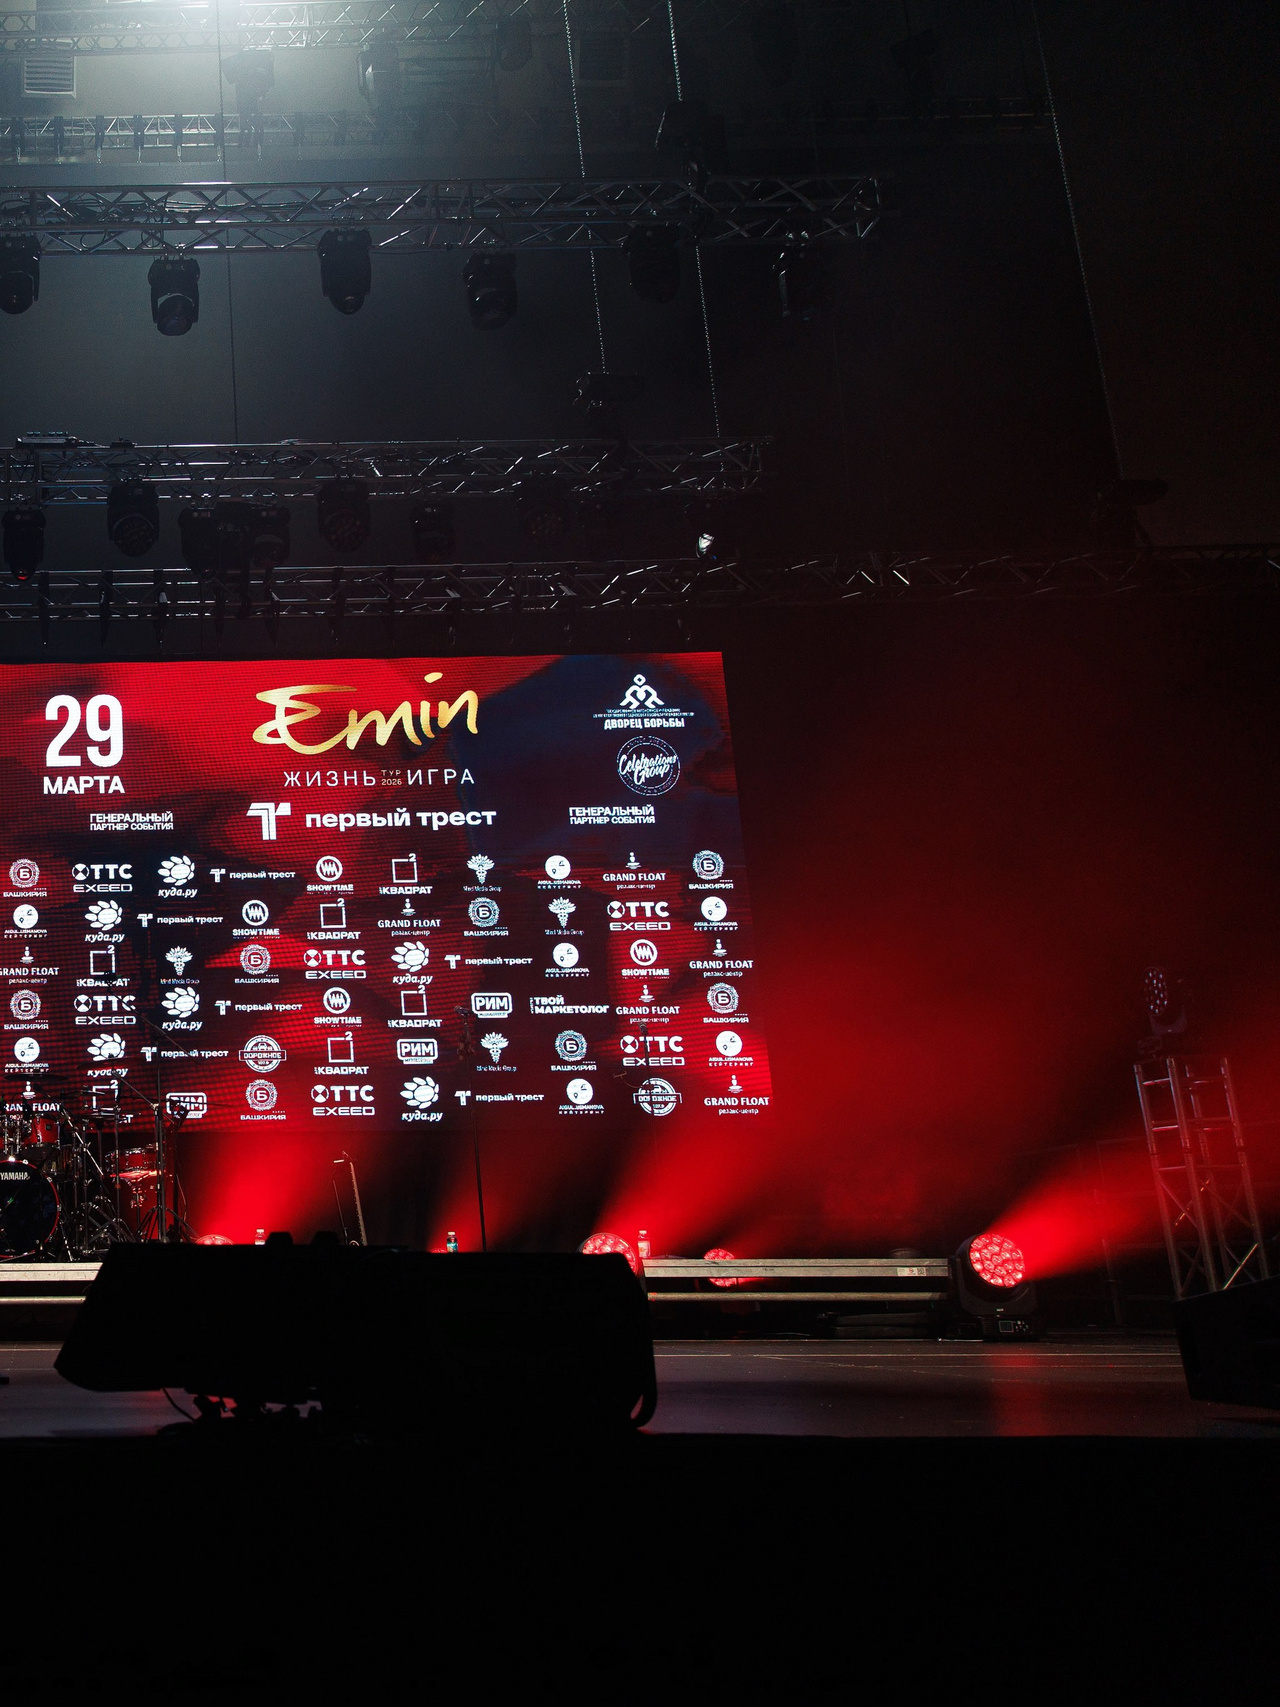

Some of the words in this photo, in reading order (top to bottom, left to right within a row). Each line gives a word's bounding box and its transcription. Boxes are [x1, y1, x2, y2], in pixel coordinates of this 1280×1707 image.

[604, 719, 642, 730] ДВОРЕЦ
[644, 717, 685, 728] БОРЬБЫ
[46, 694, 123, 767] 29
[619, 753, 677, 775] Celebrations
[284, 771, 375, 786] ЖИЗНЬ
[407, 769, 474, 785] ИГРА
[634, 764, 670, 785] Group
[44, 776, 125, 794] МАРТА
[569, 804, 654, 817] ГЕНЕРАЛЬНЫЙ
[90, 811, 173, 822] ГЕНЕРАЛЬНЫЙ
[306, 808, 410, 829] первый
[416, 811, 496, 830] трест
[570, 817, 609, 825] ПАРТНЕР
[612, 816, 655, 824] СОБЫТИЯ
[90, 823, 129, 831] ПАРТНЕР
[131, 823, 173, 831] СОБЫТИЯ
[229, 870, 266, 880] первый
[268, 871, 296, 880] трест
[602, 872, 637, 882] GRAND
[637, 872, 667, 881] FLOAT
[72, 883, 133, 893] EXEED
[158, 887, 198, 898] куда.ру
[306, 883, 354, 892] SHOWTIME
[156, 915, 193, 925] первый
[195, 916, 224, 925] трест
[377, 919, 411, 928] GRAND
[412, 919, 441, 928] FLOAT
[609, 921, 671, 931] EXEED
[232, 928, 280, 936] SHOWTIME
[85, 932, 125, 943] куда.ру
[464, 956, 502, 966] первый
[504, 957, 533, 966] трест
[688, 960, 724, 969] GRAND
[724, 959, 754, 969] FLOAT
[30, 967, 60, 976] FLOAT
[305, 969, 367, 980] EXEED
[621, 968, 670, 977] SHOWTIME
[393, 974, 433, 984] куда.ру
[476, 997, 508, 1010] РИМ
[534, 995, 564, 1005] ТВОЙ
[234, 1002, 272, 1012] первый
[274, 1003, 303, 1012] трест
[534, 1004, 610, 1014] МАРКЕТОЛОГ
[615, 1006, 650, 1015] GRAND
[651, 1005, 681, 1015] FLOAT
[74, 1015, 137, 1025] EXEED
[162, 1020, 202, 1030] куда.ру
[313, 1016, 363, 1025] SHOWTIME
[200, 1050, 229, 1059] трест
[402, 1043, 433, 1056] РИМ
[623, 1057, 685, 1066] EXEED
[475, 1093, 514, 1103] первый
[515, 1094, 545, 1102] трест
[703, 1097, 739, 1106] GRAND
[740, 1096, 770, 1106] FLOAT
[312, 1106, 376, 1116] EXEED
[402, 1110, 442, 1121] куда.ру
[0, 1172, 29, 1180] YAMAHA
